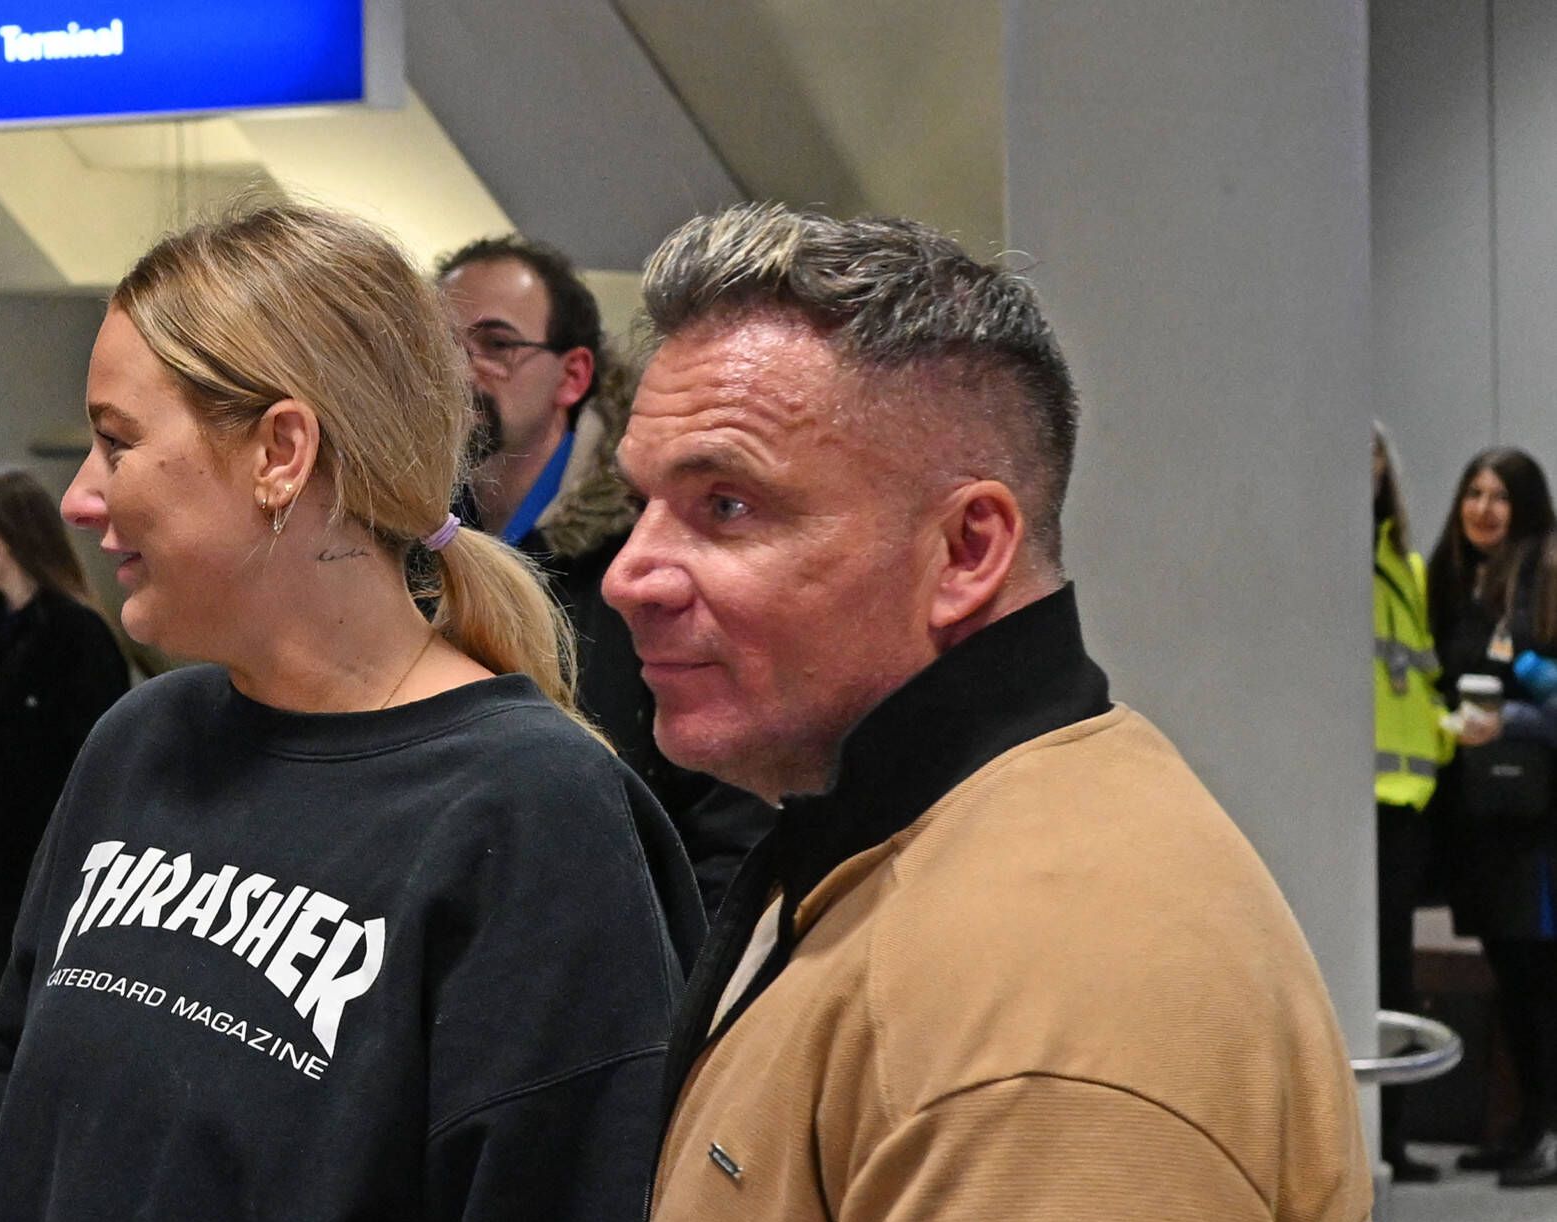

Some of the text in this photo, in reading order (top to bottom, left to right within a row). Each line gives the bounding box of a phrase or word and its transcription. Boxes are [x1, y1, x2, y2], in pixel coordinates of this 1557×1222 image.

[46, 968, 330, 1081] ATEBOARD MAGAZINE
[52, 840, 386, 1059] THRASHER
